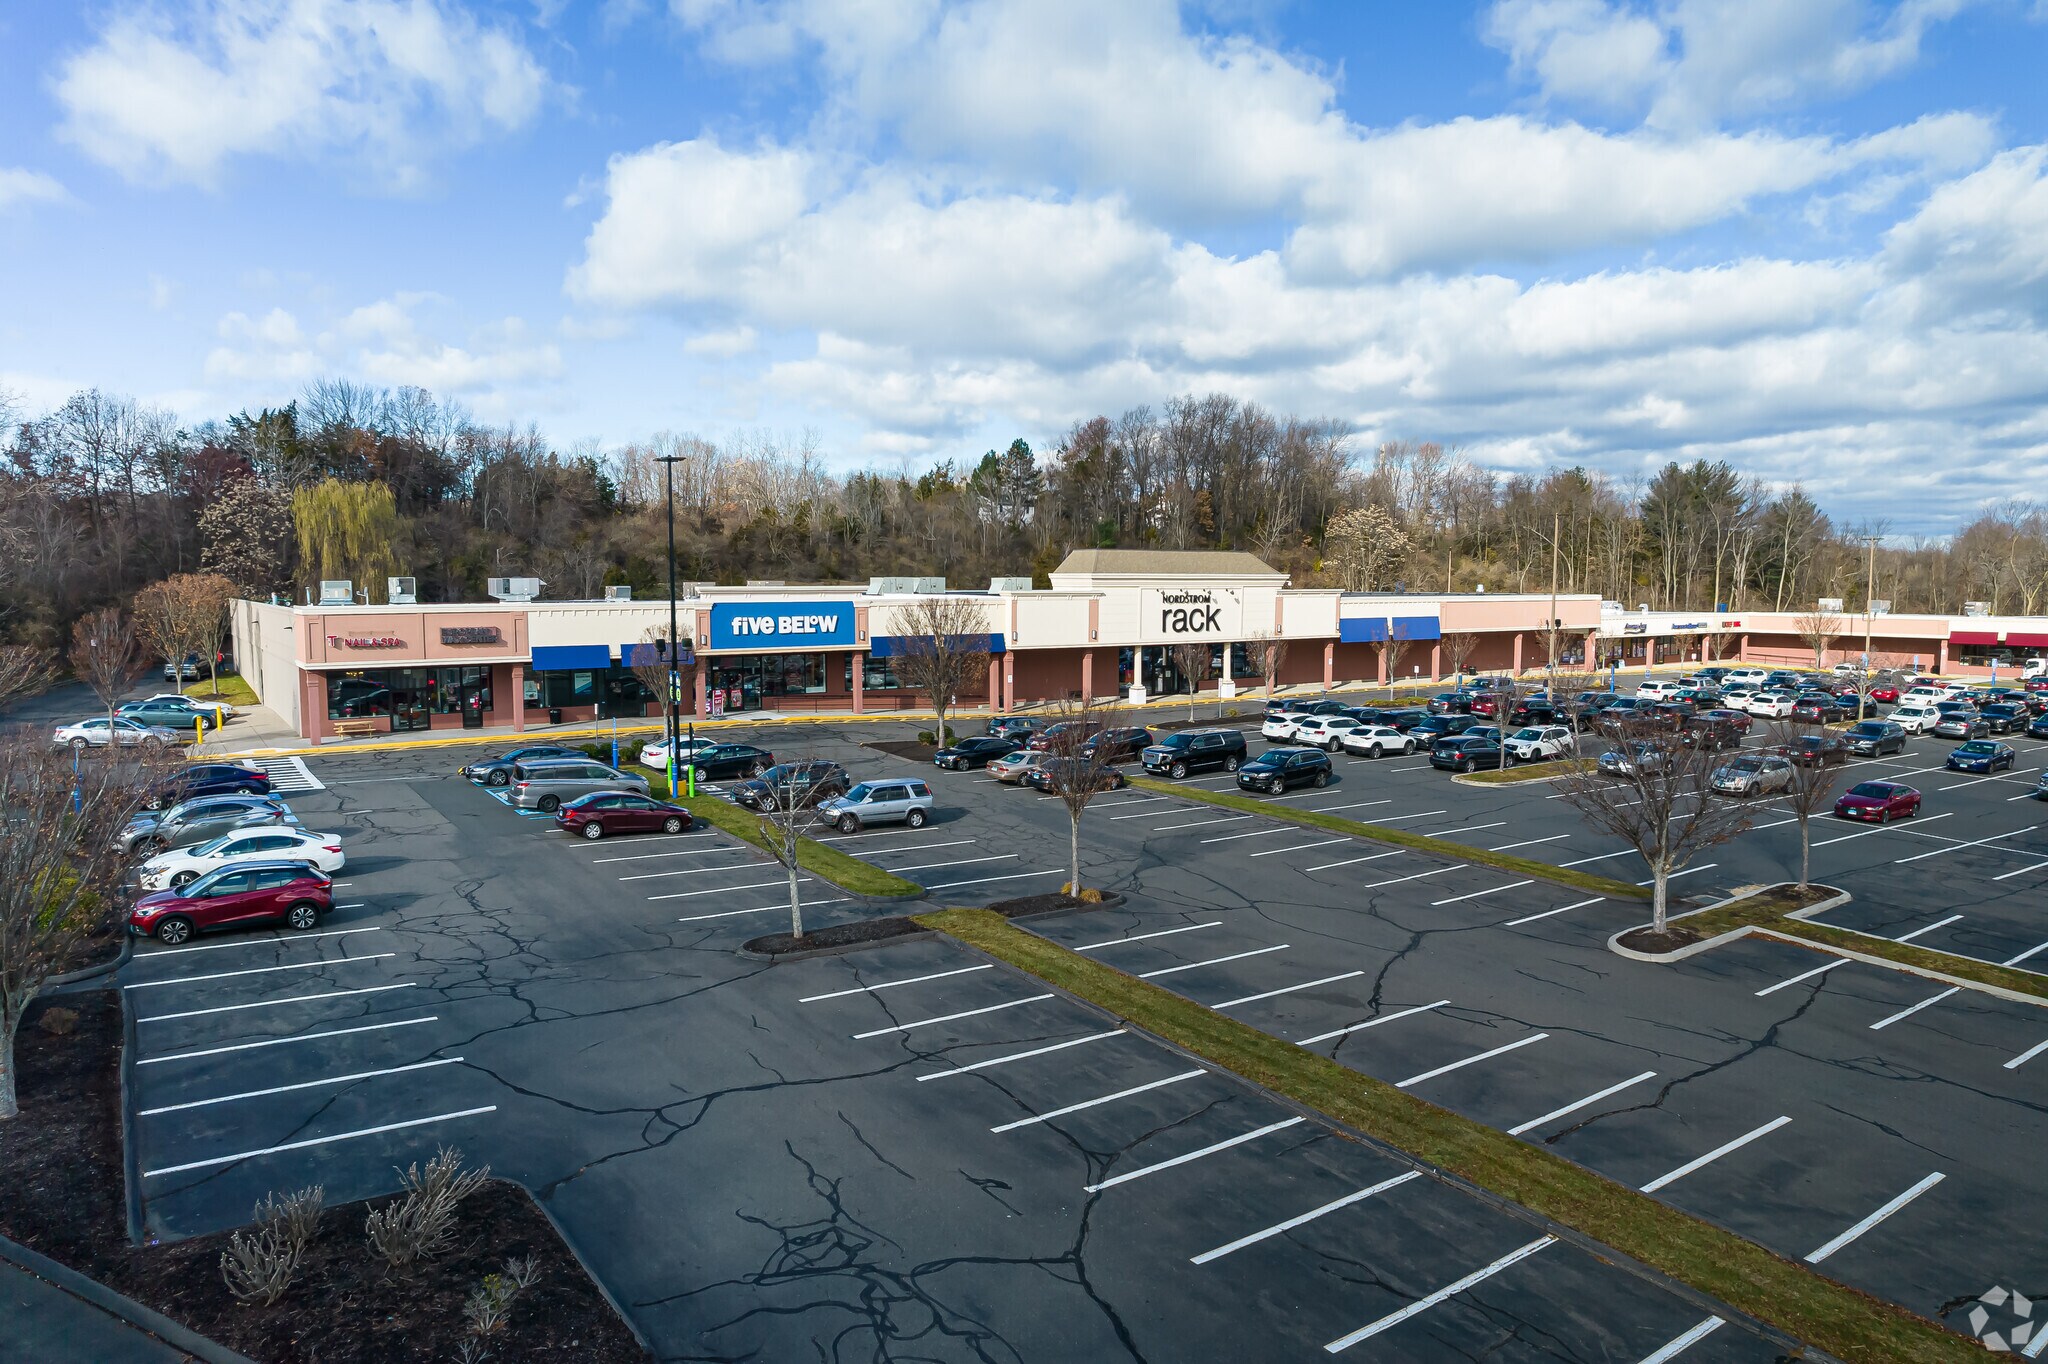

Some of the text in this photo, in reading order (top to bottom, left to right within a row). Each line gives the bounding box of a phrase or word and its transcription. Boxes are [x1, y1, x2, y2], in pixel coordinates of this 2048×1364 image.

[1162, 593, 1211, 604] NORDSTROM
[731, 616, 775, 635] five
[1162, 605, 1222, 633] rack
[344, 638, 370, 647] NAIL
[380, 637, 401, 647] SPA
